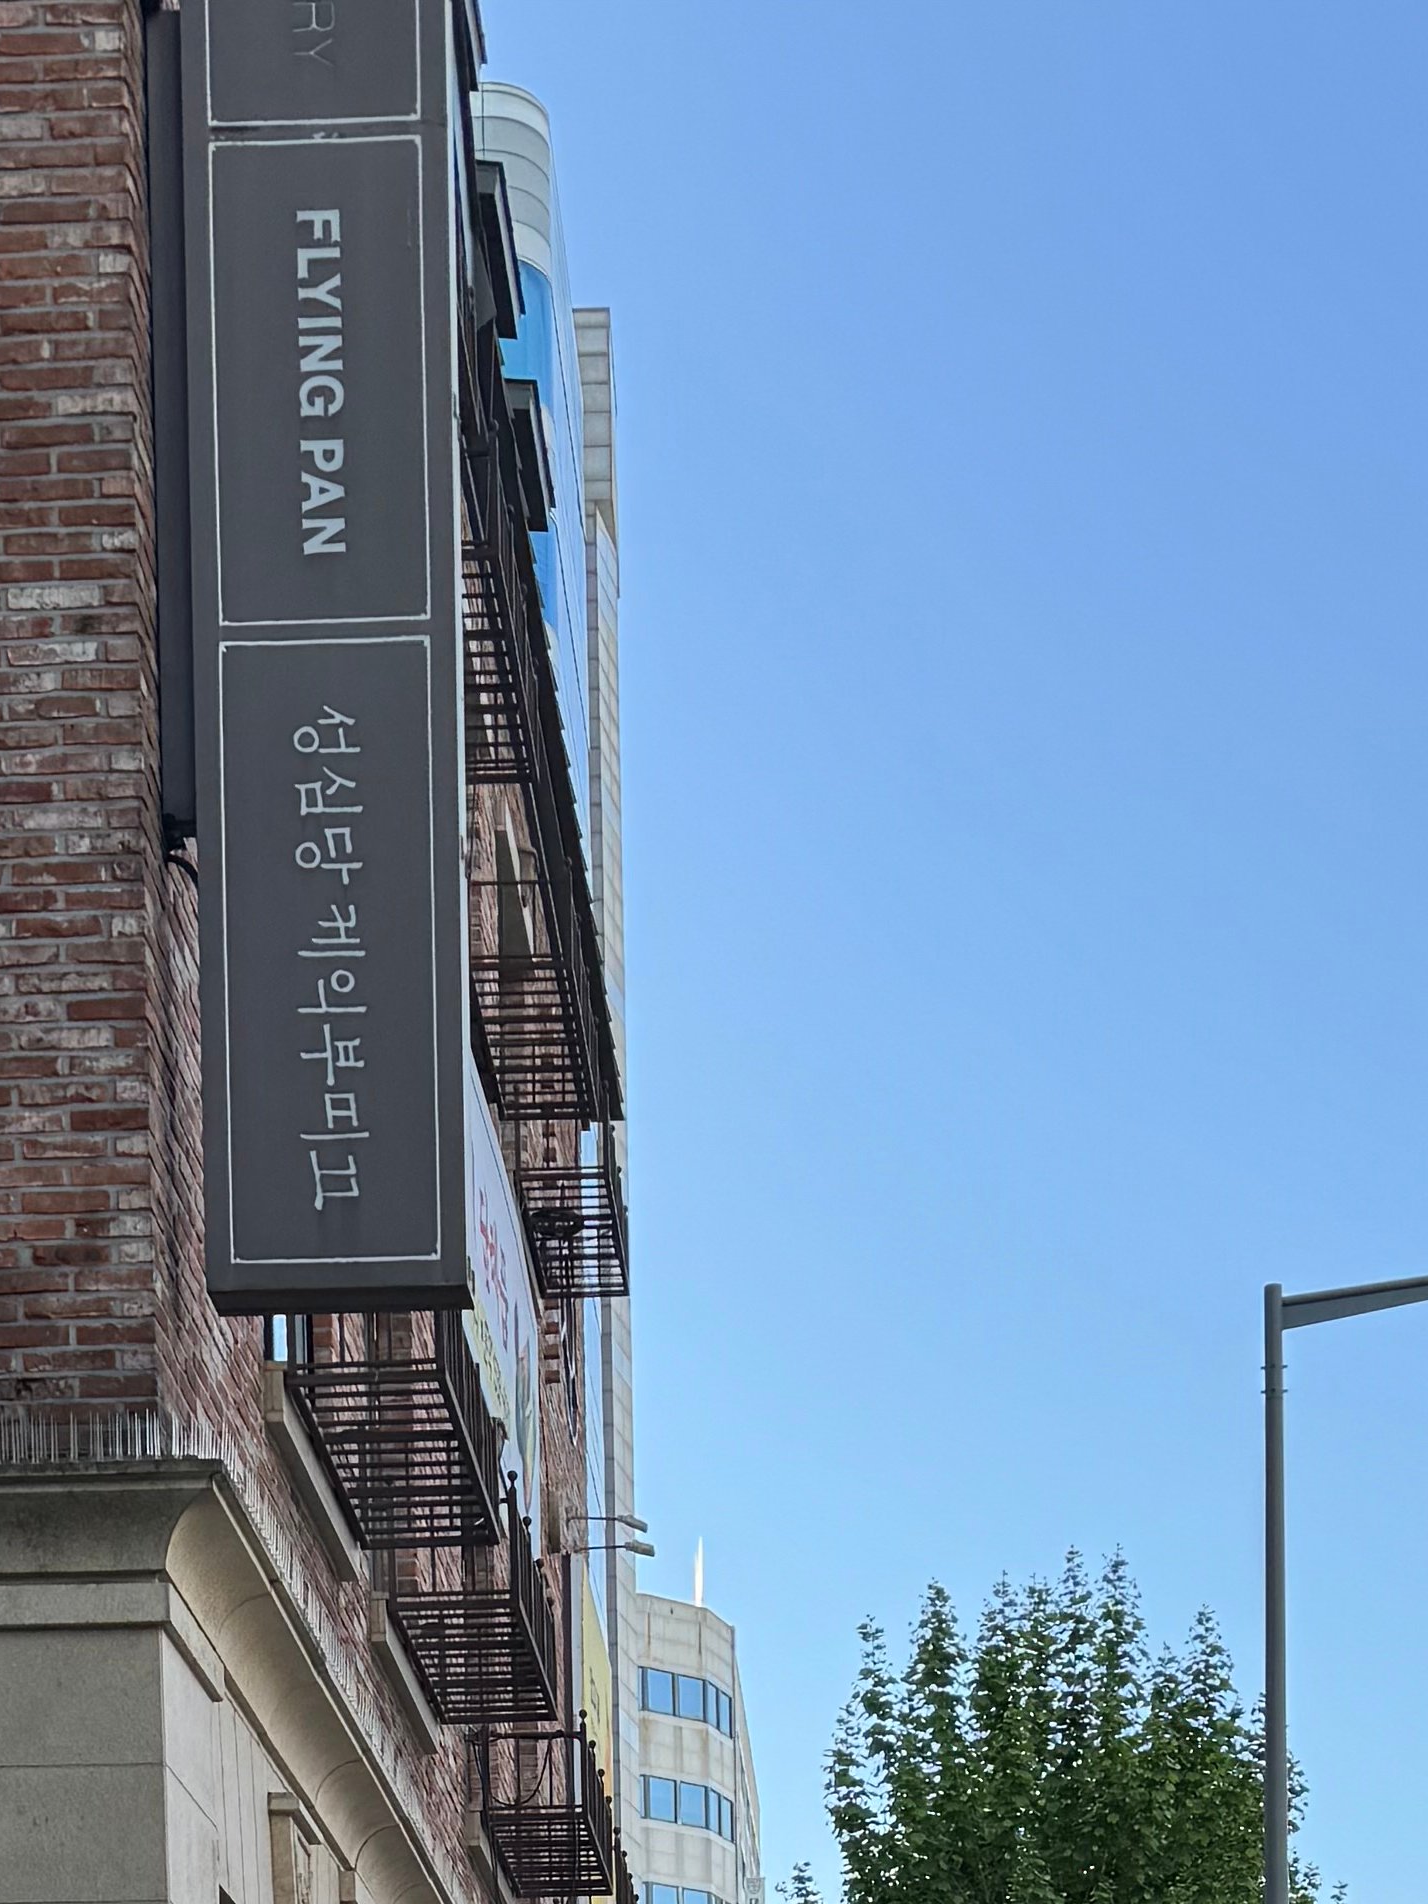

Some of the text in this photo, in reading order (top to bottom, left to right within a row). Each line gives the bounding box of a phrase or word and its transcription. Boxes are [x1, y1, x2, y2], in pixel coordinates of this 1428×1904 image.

[295, 208, 347, 555] FLYING PAN
[292, 704, 363, 886] 성심당
